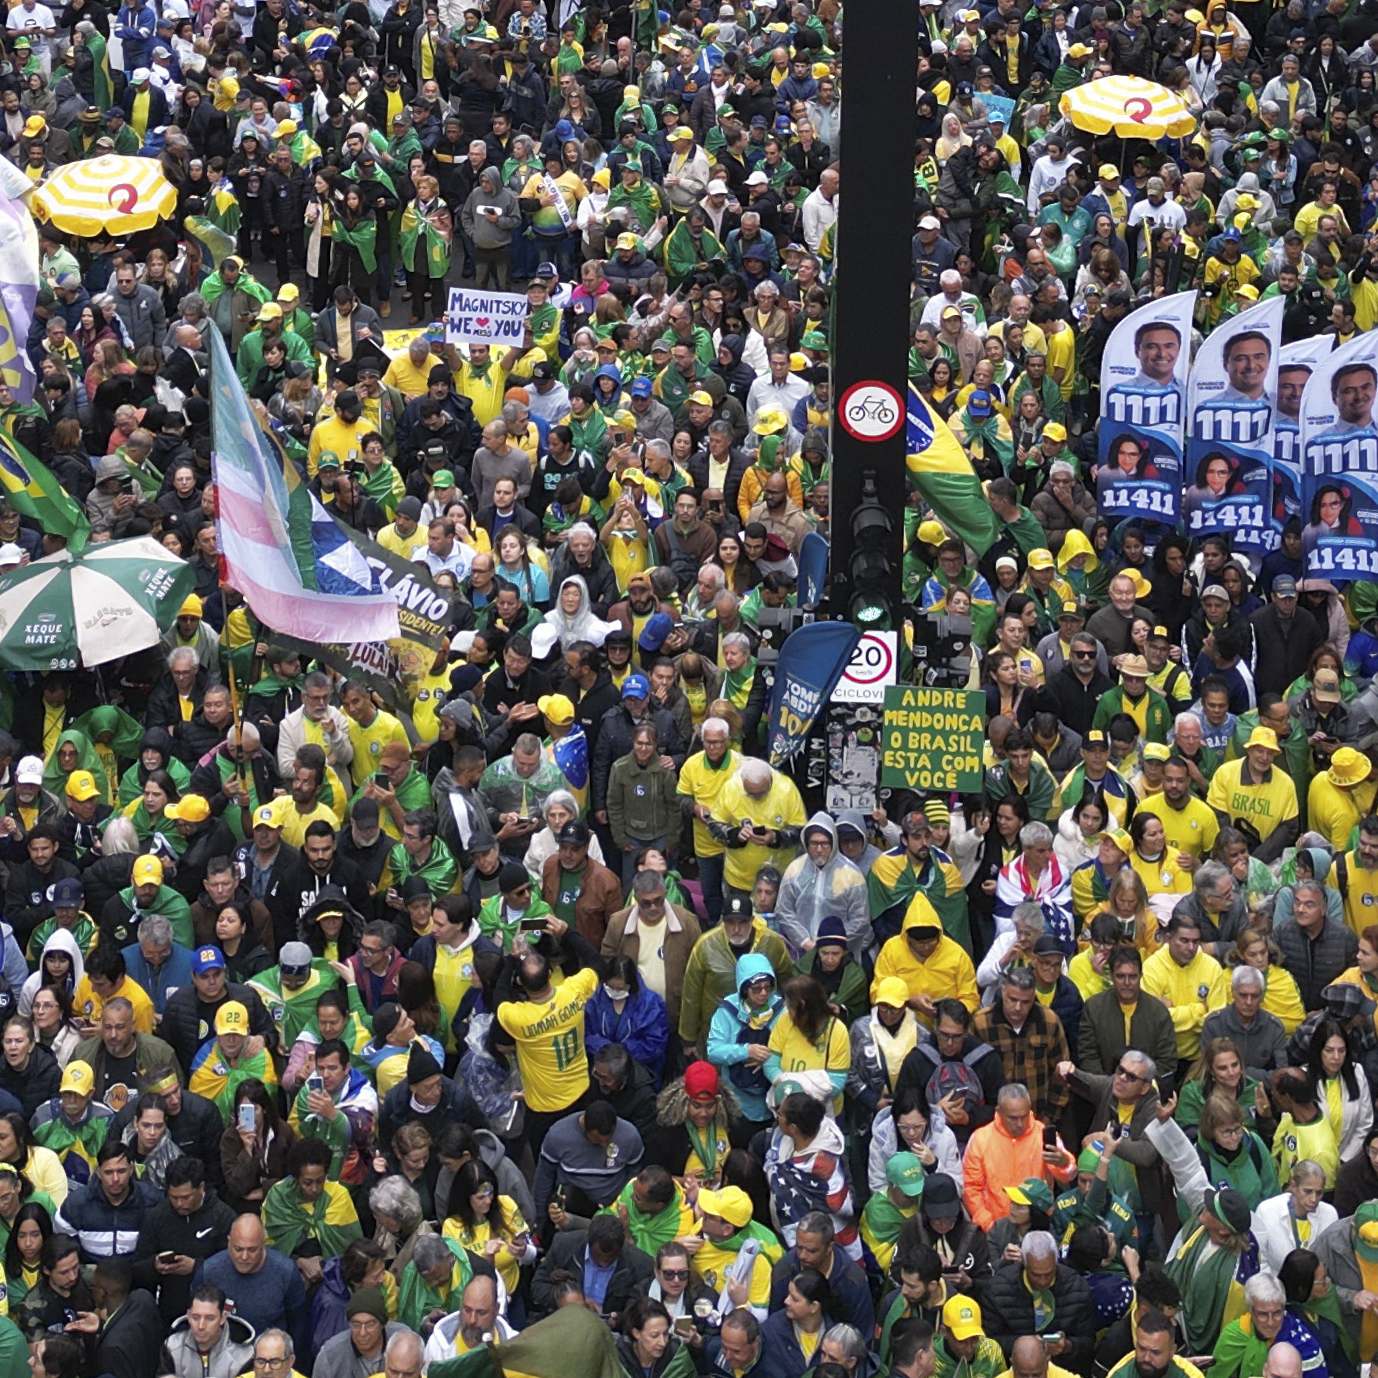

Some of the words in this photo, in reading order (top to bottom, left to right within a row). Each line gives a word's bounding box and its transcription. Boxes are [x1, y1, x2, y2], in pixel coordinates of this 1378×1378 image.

[450, 292, 526, 315] MAGNITSKY
[450, 317, 473, 334] WE
[494, 320, 521, 337] YOU
[1109, 393, 1177, 424] 1111
[1197, 409, 1268, 441] 1111
[1307, 439, 1378, 475] 1111
[1103, 489, 1174, 515] 11411
[1190, 505, 1263, 528] 11411
[144, 567, 167, 596] XEQUE
[156, 575, 176, 600] MATE
[25, 624, 62, 633] XEQUE
[25, 635, 56, 644] MATE
[850, 647, 881, 666] 20
[834, 689, 883, 698] CICLOVI
[902, 690, 969, 709] ANDRÉ
[884, 710, 983, 732] MENDONÇA
[891, 732, 902, 748] O
[909, 733, 976, 752] BRASIL
[884, 751, 931, 769] ESTÁ
[942, 755, 980, 773] COM
[905, 769, 957, 788] VOCÊ
[1232, 792, 1274, 817] BRASIL
[522, 1014, 558, 1038] LIOMAR
[552, 1026, 578, 1071] 10
